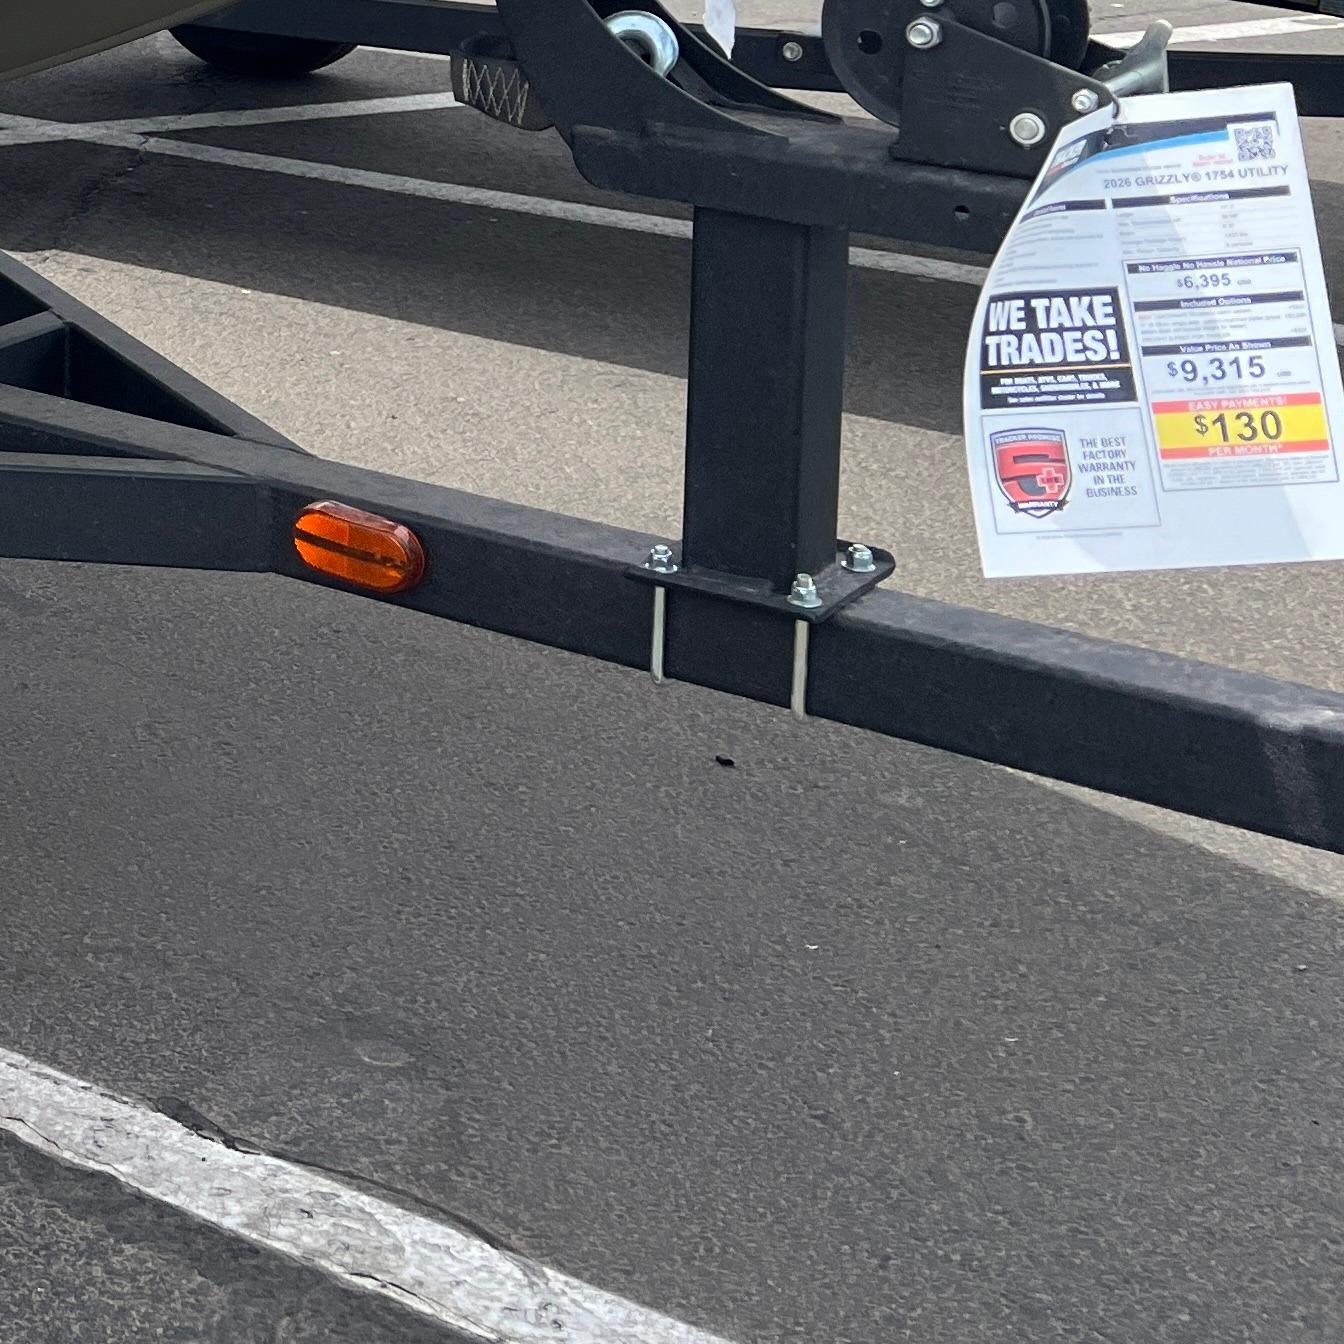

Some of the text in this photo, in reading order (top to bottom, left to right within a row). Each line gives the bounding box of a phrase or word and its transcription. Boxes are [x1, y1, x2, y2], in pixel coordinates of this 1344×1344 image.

[1104, 165, 1289, 189] 2026 GRIZZLY® 1754 UTILITY
[1169, 192, 1230, 205] Specifications
[1151, 262, 1181, 274] Haggle
[1263, 255, 1286, 264] Price
[1177, 272, 1232, 291] $6,395
[1181, 297, 1252, 308] Included Options
[989, 299, 1027, 332] WE
[1030, 295, 1116, 330] TAKE
[985, 329, 1121, 366] TRADES!
[1179, 341, 1272, 353] Value Price As Shown
[1167, 355, 1266, 386] $9,315
[1188, 397, 1287, 410] EASY PAYMENTS!
[1194, 410, 1283, 442] $130
[1080, 436, 1127, 448] THE BEST
[1083, 449, 1128, 460] FACTORY
[1208, 446, 1233, 456] PER
[1077, 461, 1137, 473] WARRANTY
[1093, 474, 1126, 485] IN THE
[1086, 485, 1138, 497] BUSINESS
